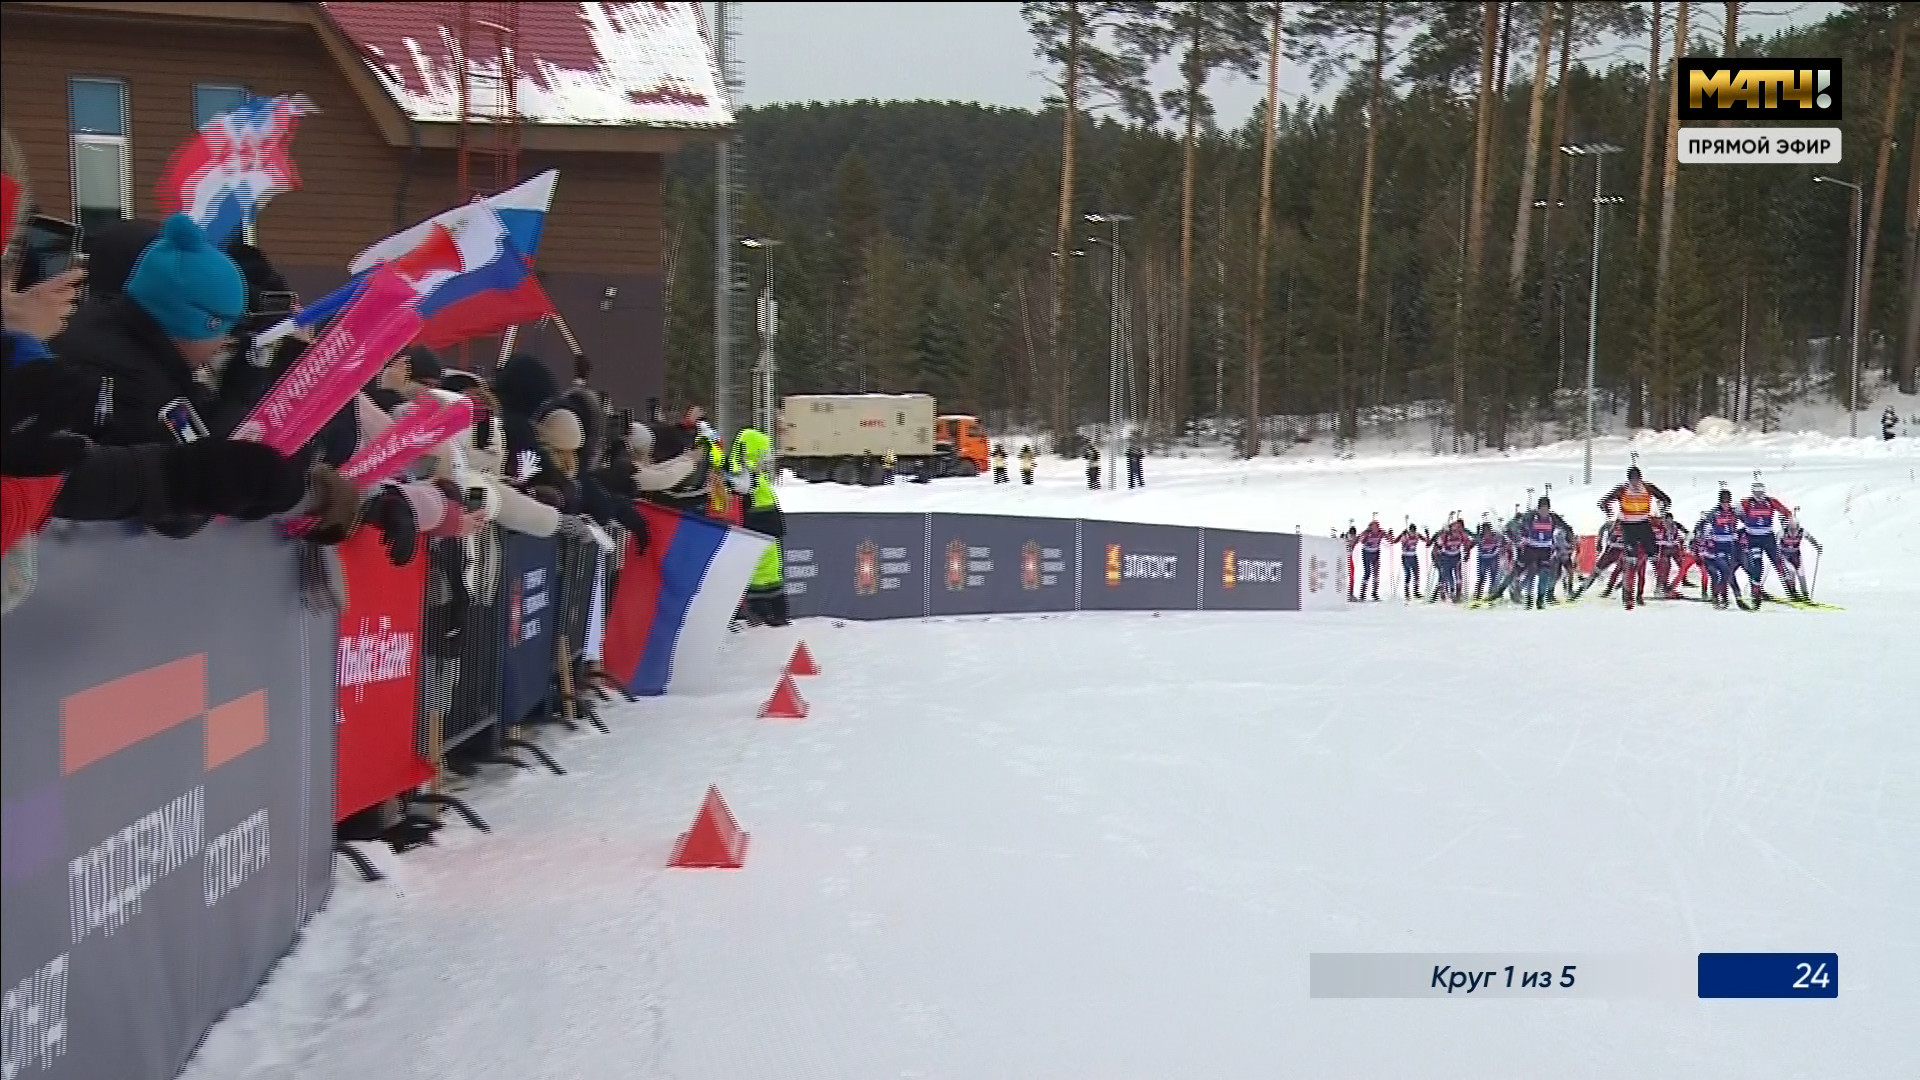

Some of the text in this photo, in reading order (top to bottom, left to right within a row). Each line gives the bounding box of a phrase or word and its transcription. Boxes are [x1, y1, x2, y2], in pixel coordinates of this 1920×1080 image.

[1122, 554, 1178, 580] ЗЛАТОУСТ
[1235, 559, 1283, 583] ЗЛАТОУСТ
[373, 614, 413, 681] Банк
[68, 784, 205, 945] ПОДДЕРЖКИ
[203, 807, 271, 908] СПОРТА
